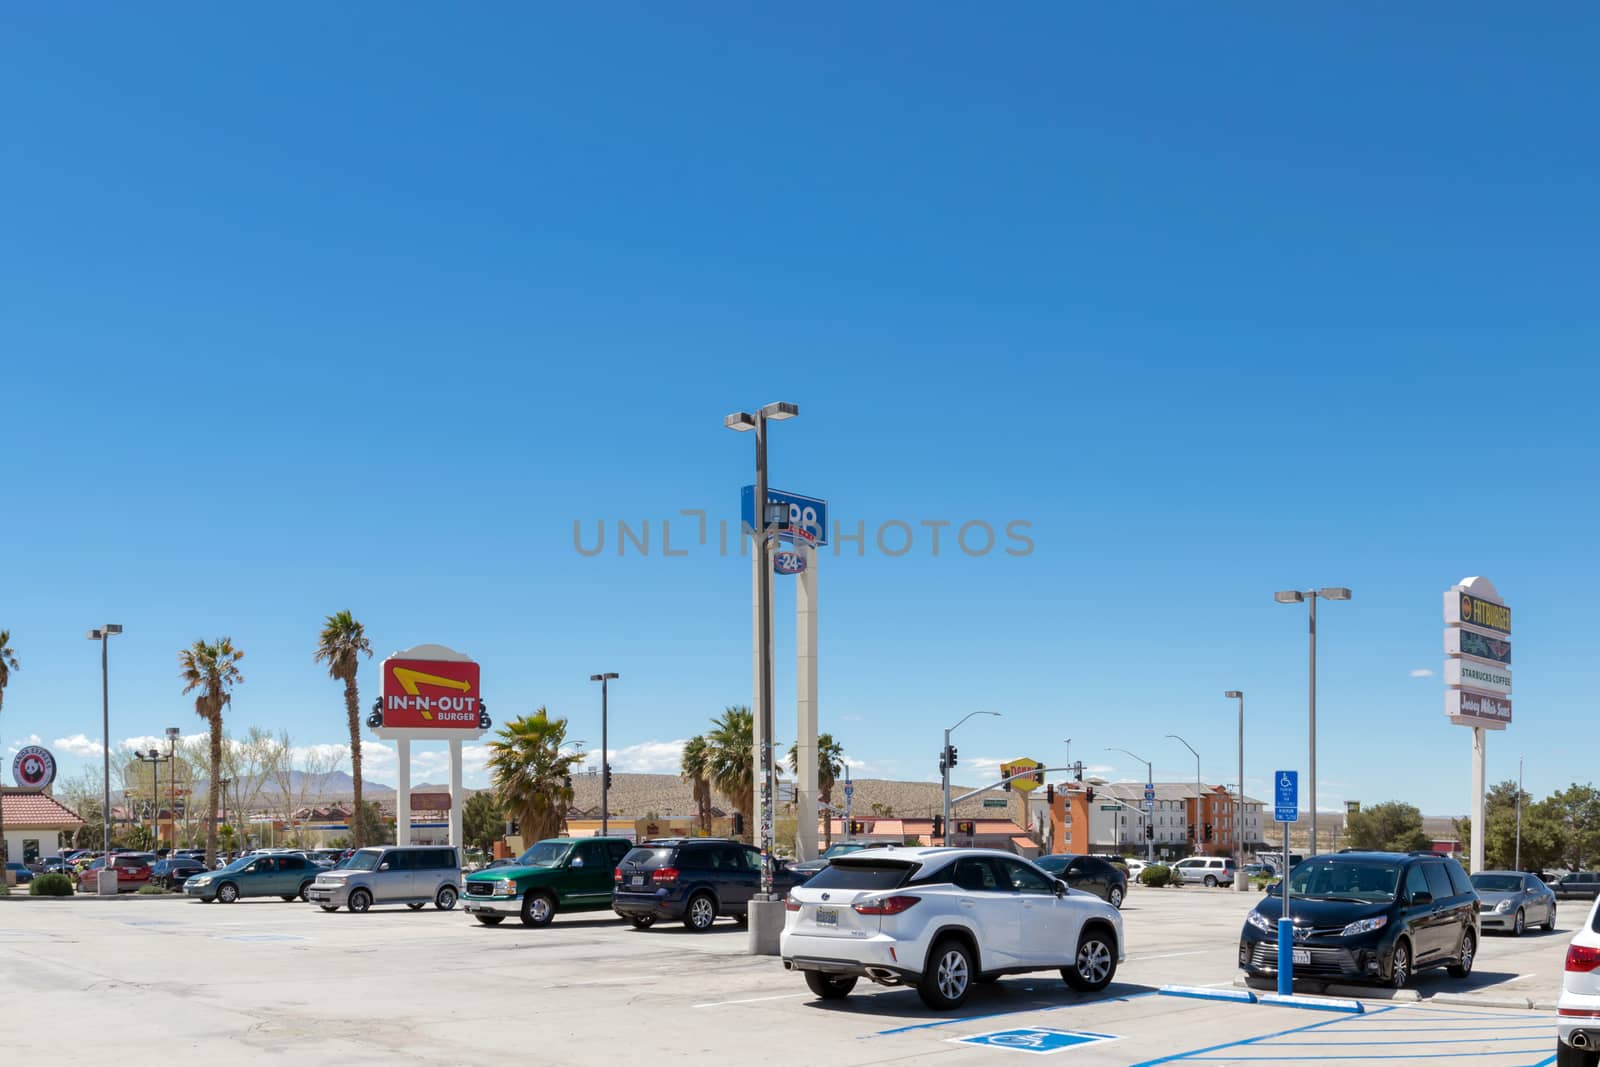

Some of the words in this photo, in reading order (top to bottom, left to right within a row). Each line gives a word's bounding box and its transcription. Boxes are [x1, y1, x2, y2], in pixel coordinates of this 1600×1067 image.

[1462, 668, 1492, 683] STARBUCKS
[388, 695, 475, 712] IN-N-OUT
[438, 712, 474, 721] BURGER
